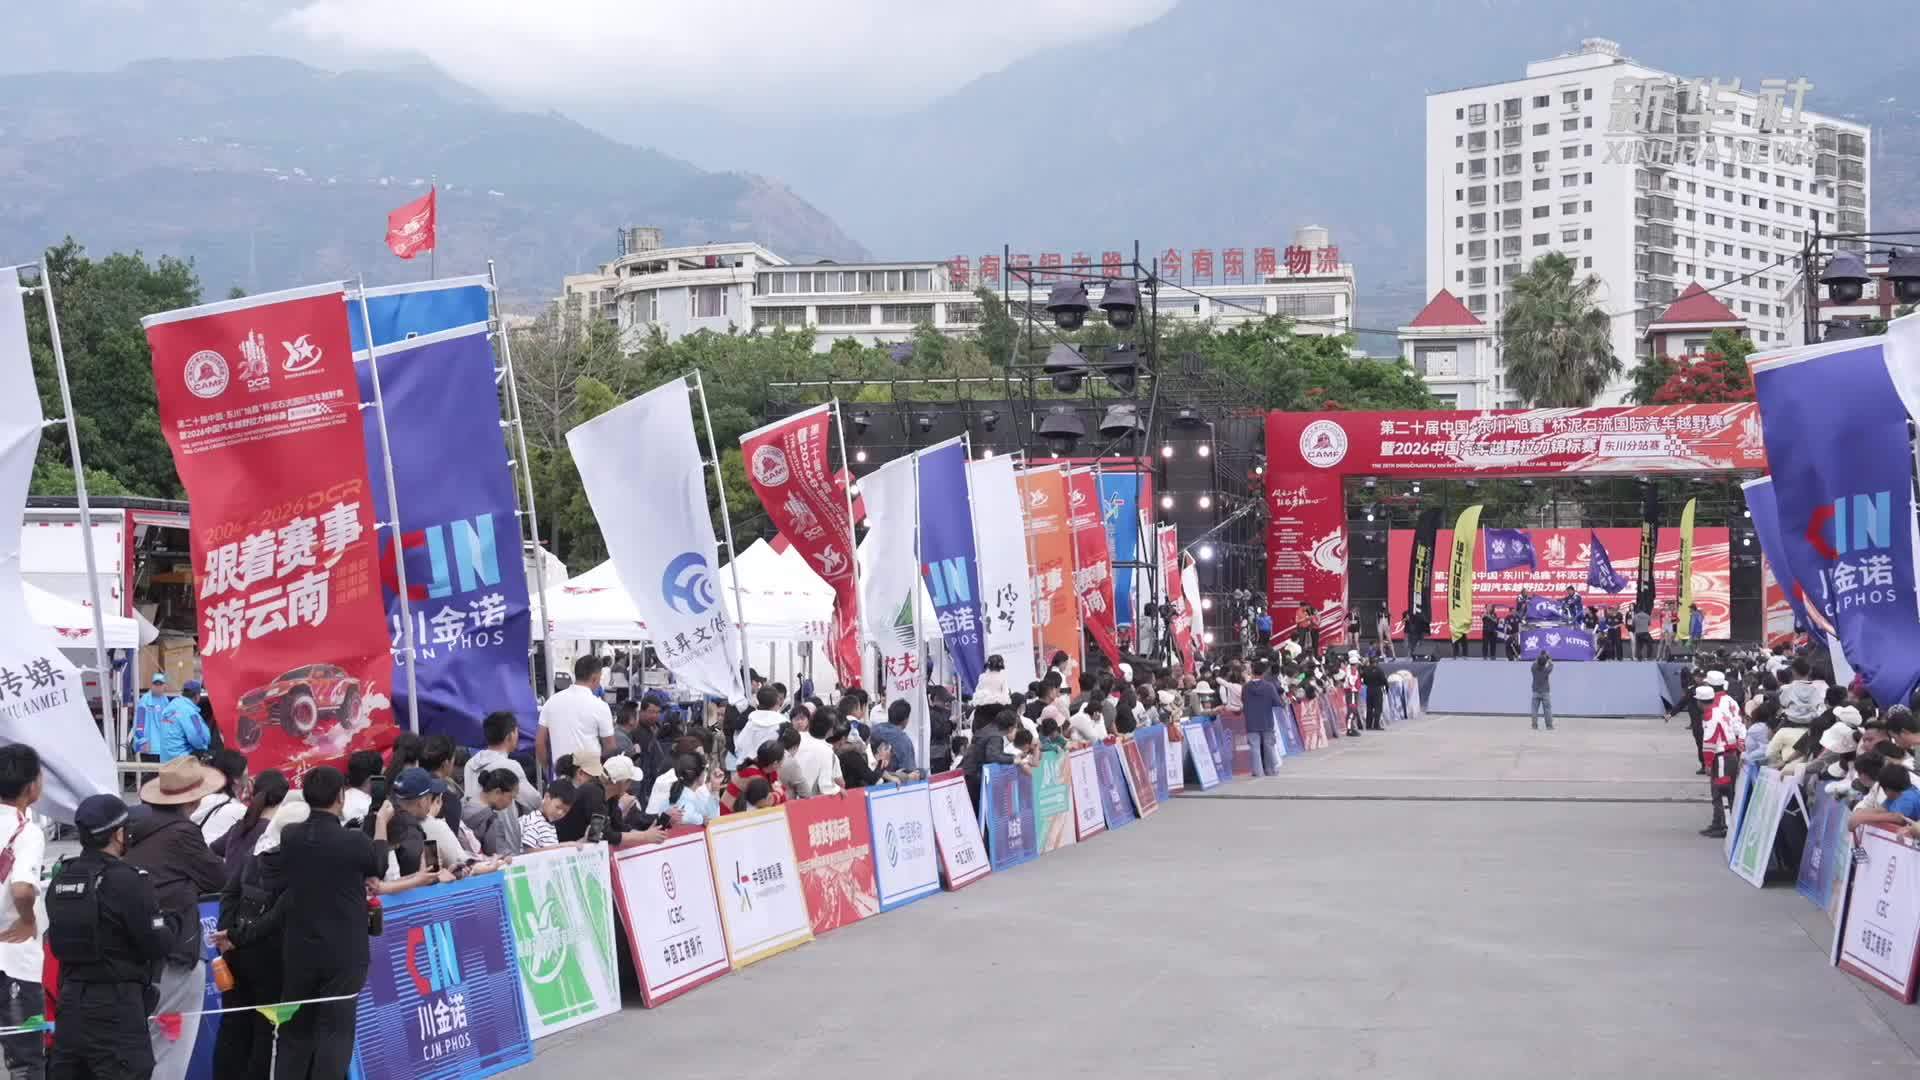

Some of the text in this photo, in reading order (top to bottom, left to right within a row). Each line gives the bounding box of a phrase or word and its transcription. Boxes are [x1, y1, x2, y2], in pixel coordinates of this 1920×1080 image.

[1604, 439, 1661, 452] 东川分站赛
[200, 502, 363, 600] 跟着赛事
[200, 571, 330, 657] 游云南
[668, 905, 686, 927] ICBC
[662, 935, 704, 969] 中国工商银行
[418, 993, 468, 1041] 川金诺
[423, 1032, 472, 1061] CJN PHOS
